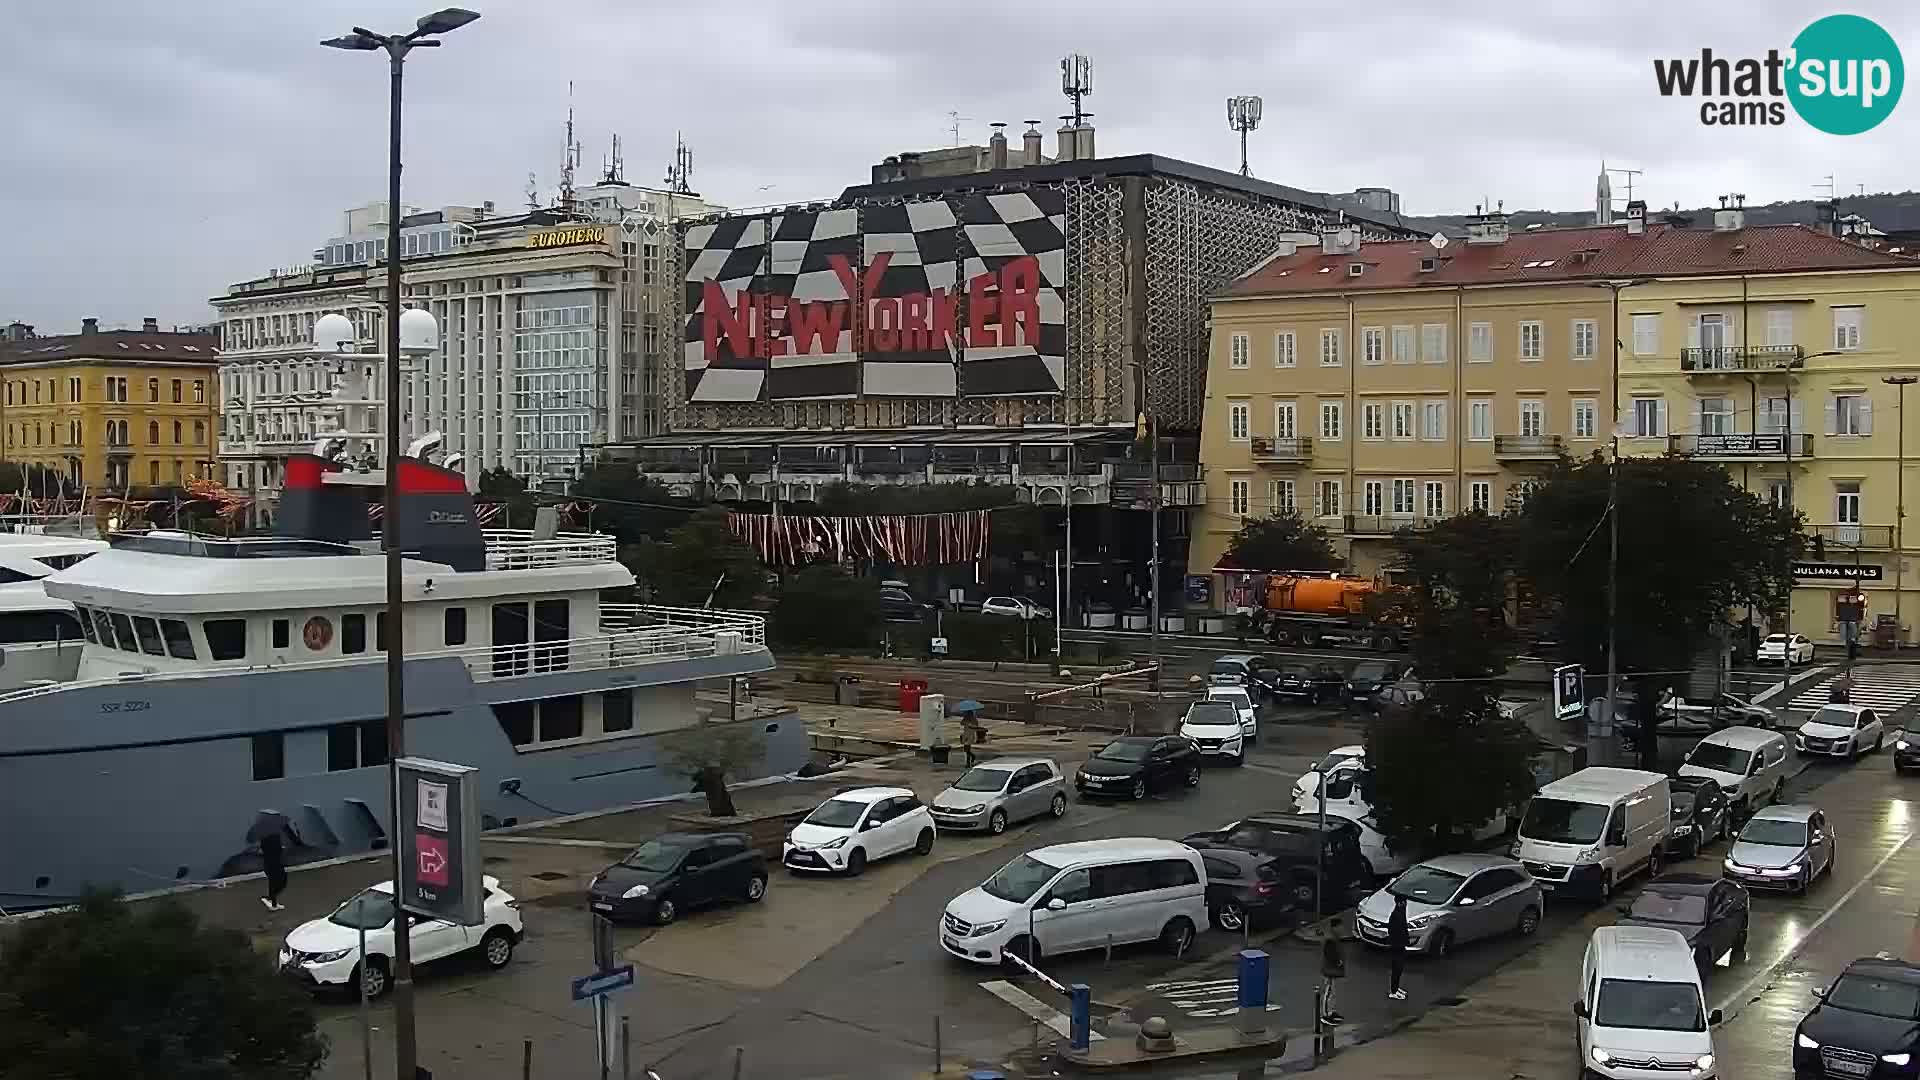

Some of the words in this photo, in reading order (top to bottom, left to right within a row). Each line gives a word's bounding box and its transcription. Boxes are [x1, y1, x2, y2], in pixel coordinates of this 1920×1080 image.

[703, 275, 849, 360] NEW
[827, 250, 1040, 352] YORKER
[1793, 567, 1840, 576] JULIANA
[1844, 568, 1877, 577] NAILS
